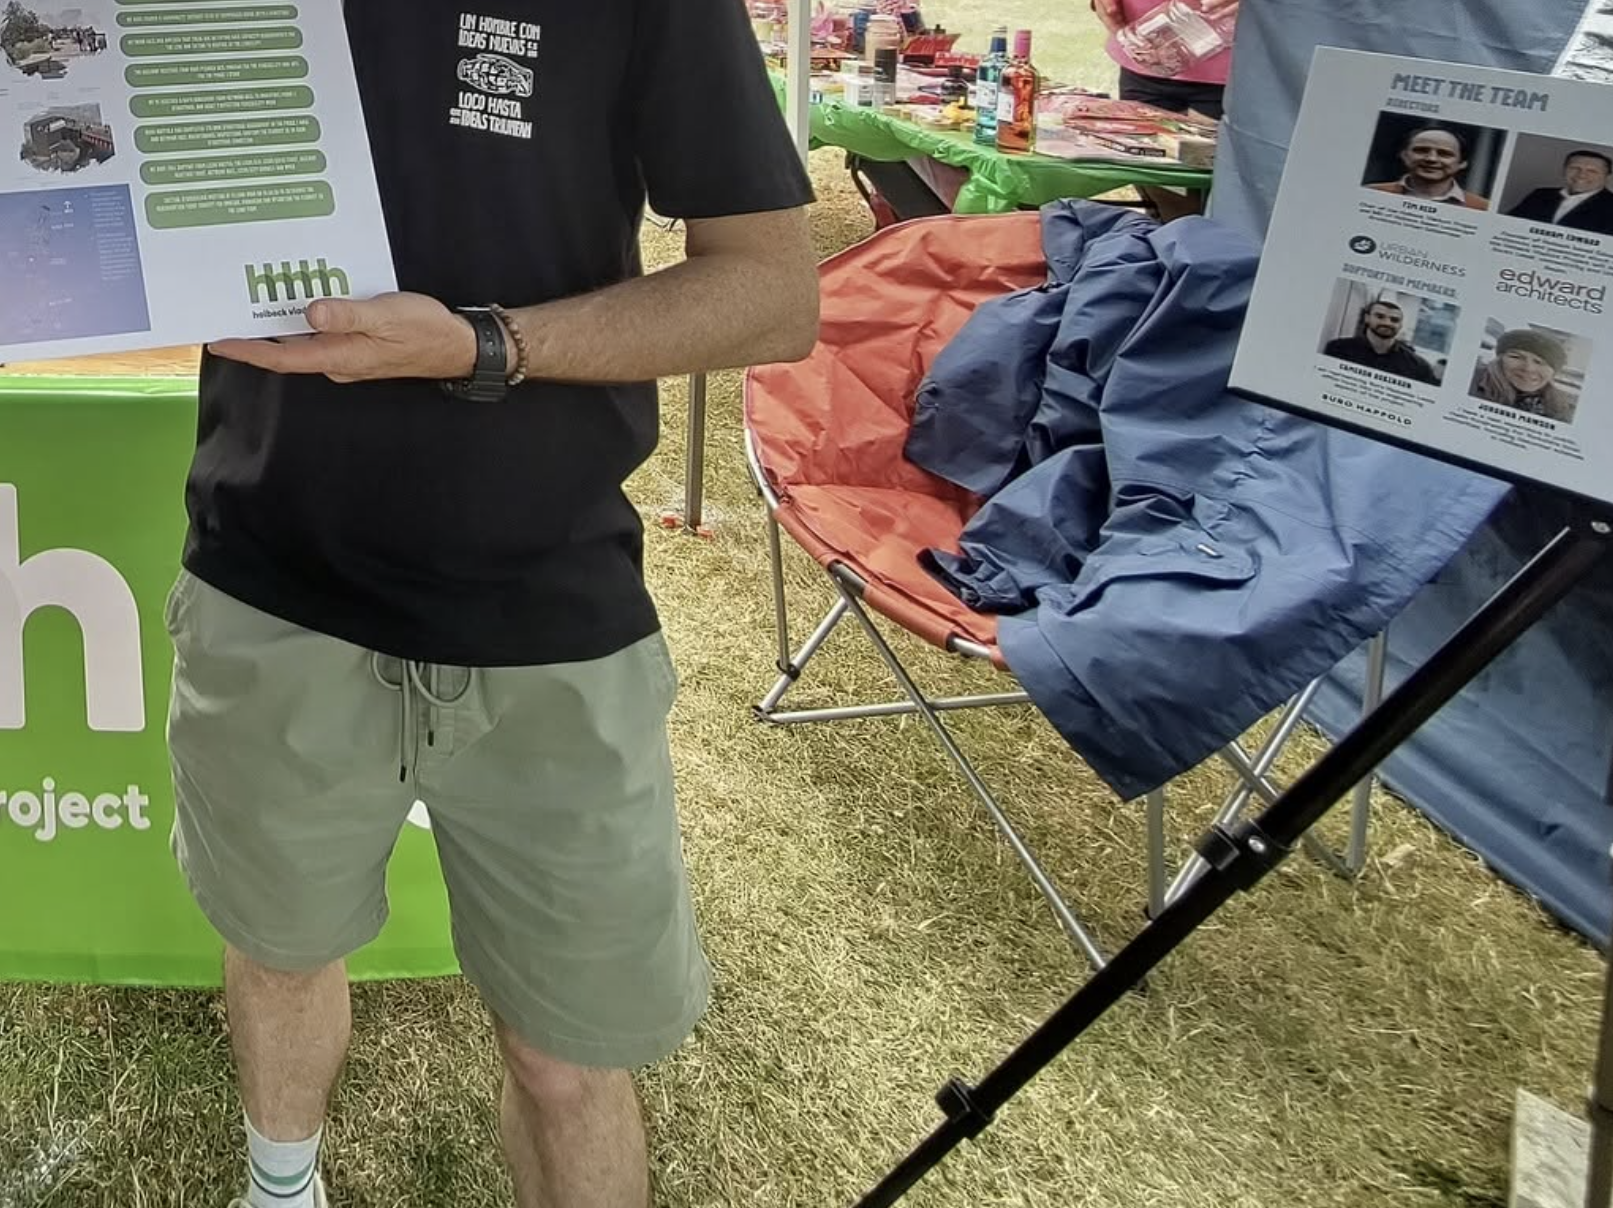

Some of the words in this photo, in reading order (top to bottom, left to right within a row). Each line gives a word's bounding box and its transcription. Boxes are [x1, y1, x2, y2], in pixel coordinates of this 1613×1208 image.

[460, 13, 477, 31] UN
[478, 16, 518, 38] HOMBRE
[519, 22, 541, 41] CON
[458, 29, 487, 50] IDEAS
[488, 34, 526, 56] NUEVAS
[458, 91, 486, 111] LOCO
[487, 96, 522, 119] HASTA
[1390, 73, 1446, 95] MEET
[1447, 80, 1486, 103] THE
[1489, 86, 1550, 112] TEAM
[461, 109, 488, 130] IDEAS
[1402, 201, 1418, 211] TIM
[1380, 242, 1428, 259] URBAN
[1378, 251, 1466, 278] WILDERNESS
[1342, 263, 1405, 286] SUPPORTING
[1406, 279, 1456, 298] MEMBERS
[1499, 268, 1606, 301] edward
[1496, 281, 1603, 314] architects
[1356, 402, 1413, 426] HAPPOLD
